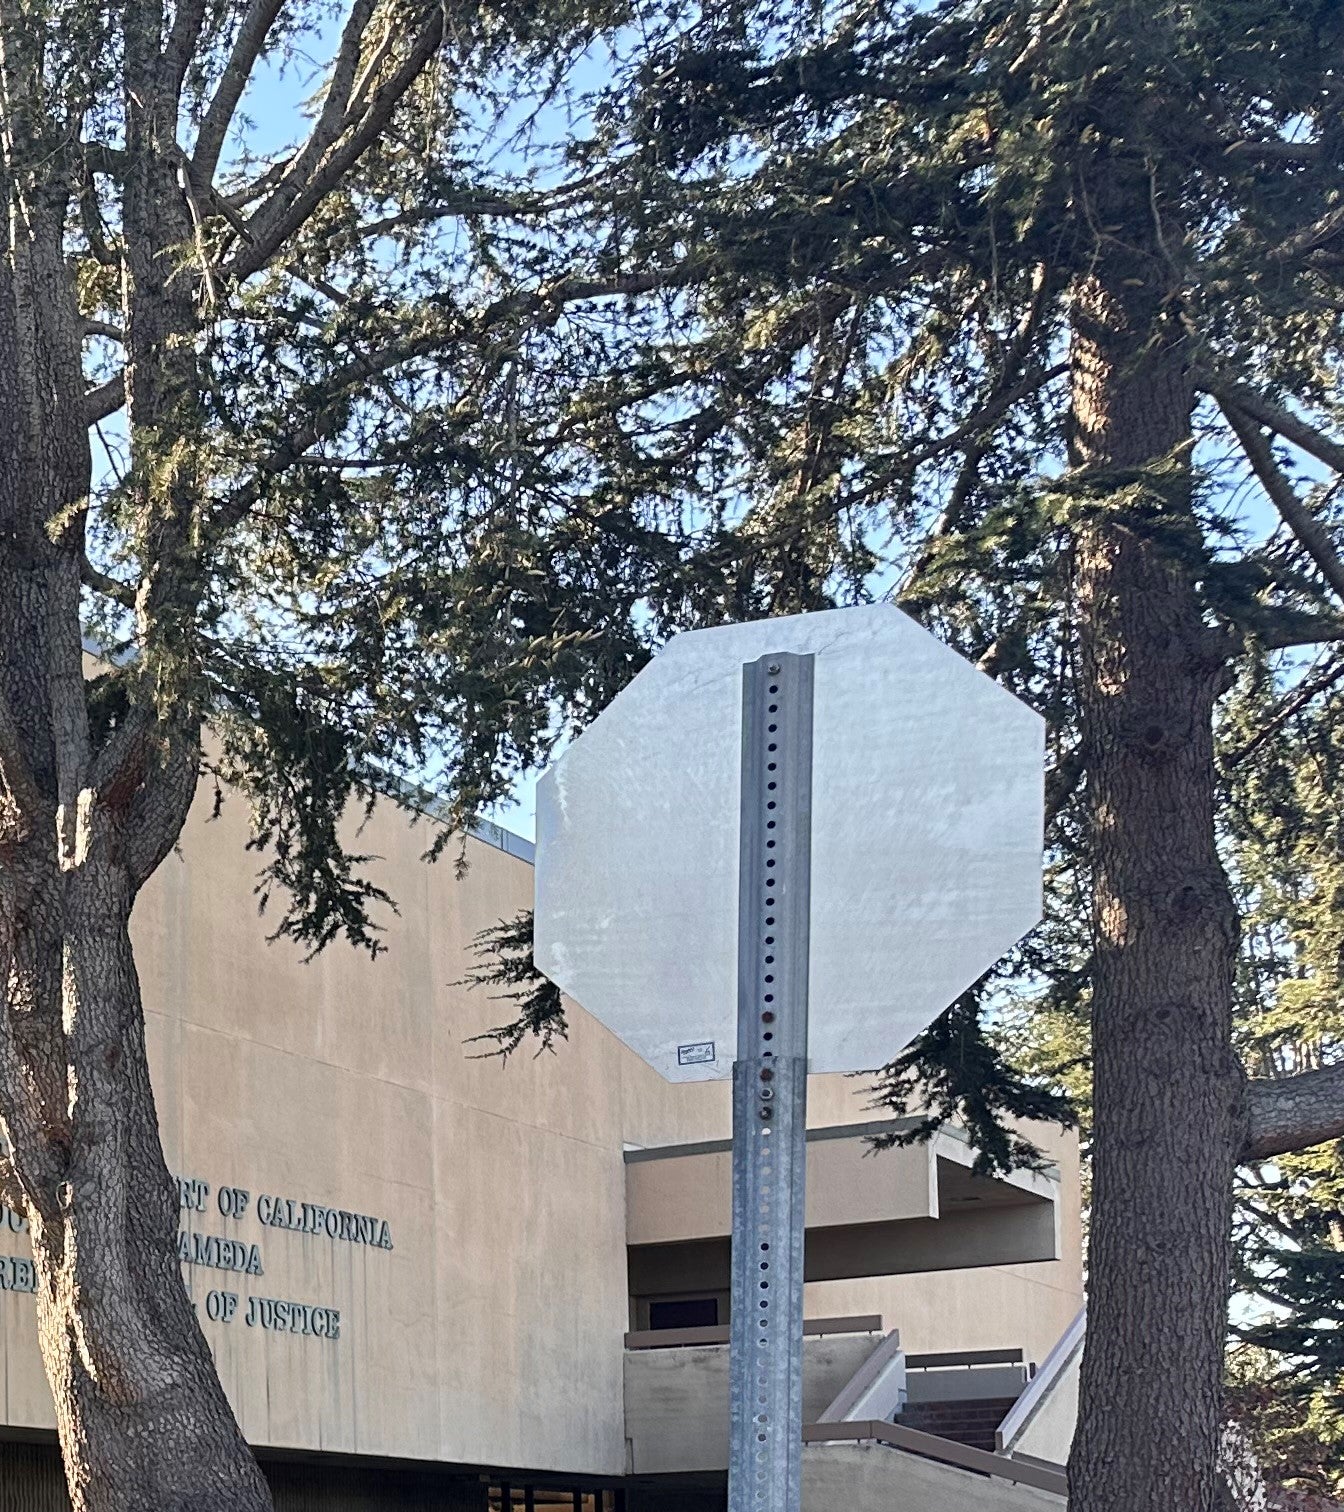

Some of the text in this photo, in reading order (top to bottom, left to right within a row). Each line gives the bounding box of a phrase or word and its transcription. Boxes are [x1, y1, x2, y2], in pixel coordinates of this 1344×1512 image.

[217, 1185, 250, 1219] OF
[257, 1193, 394, 1251] CALIFORNIA
[176, 1230, 265, 1276] AMEDA
[206, 1289, 239, 1323] OF
[245, 1296, 341, 1340] JUSTICE
